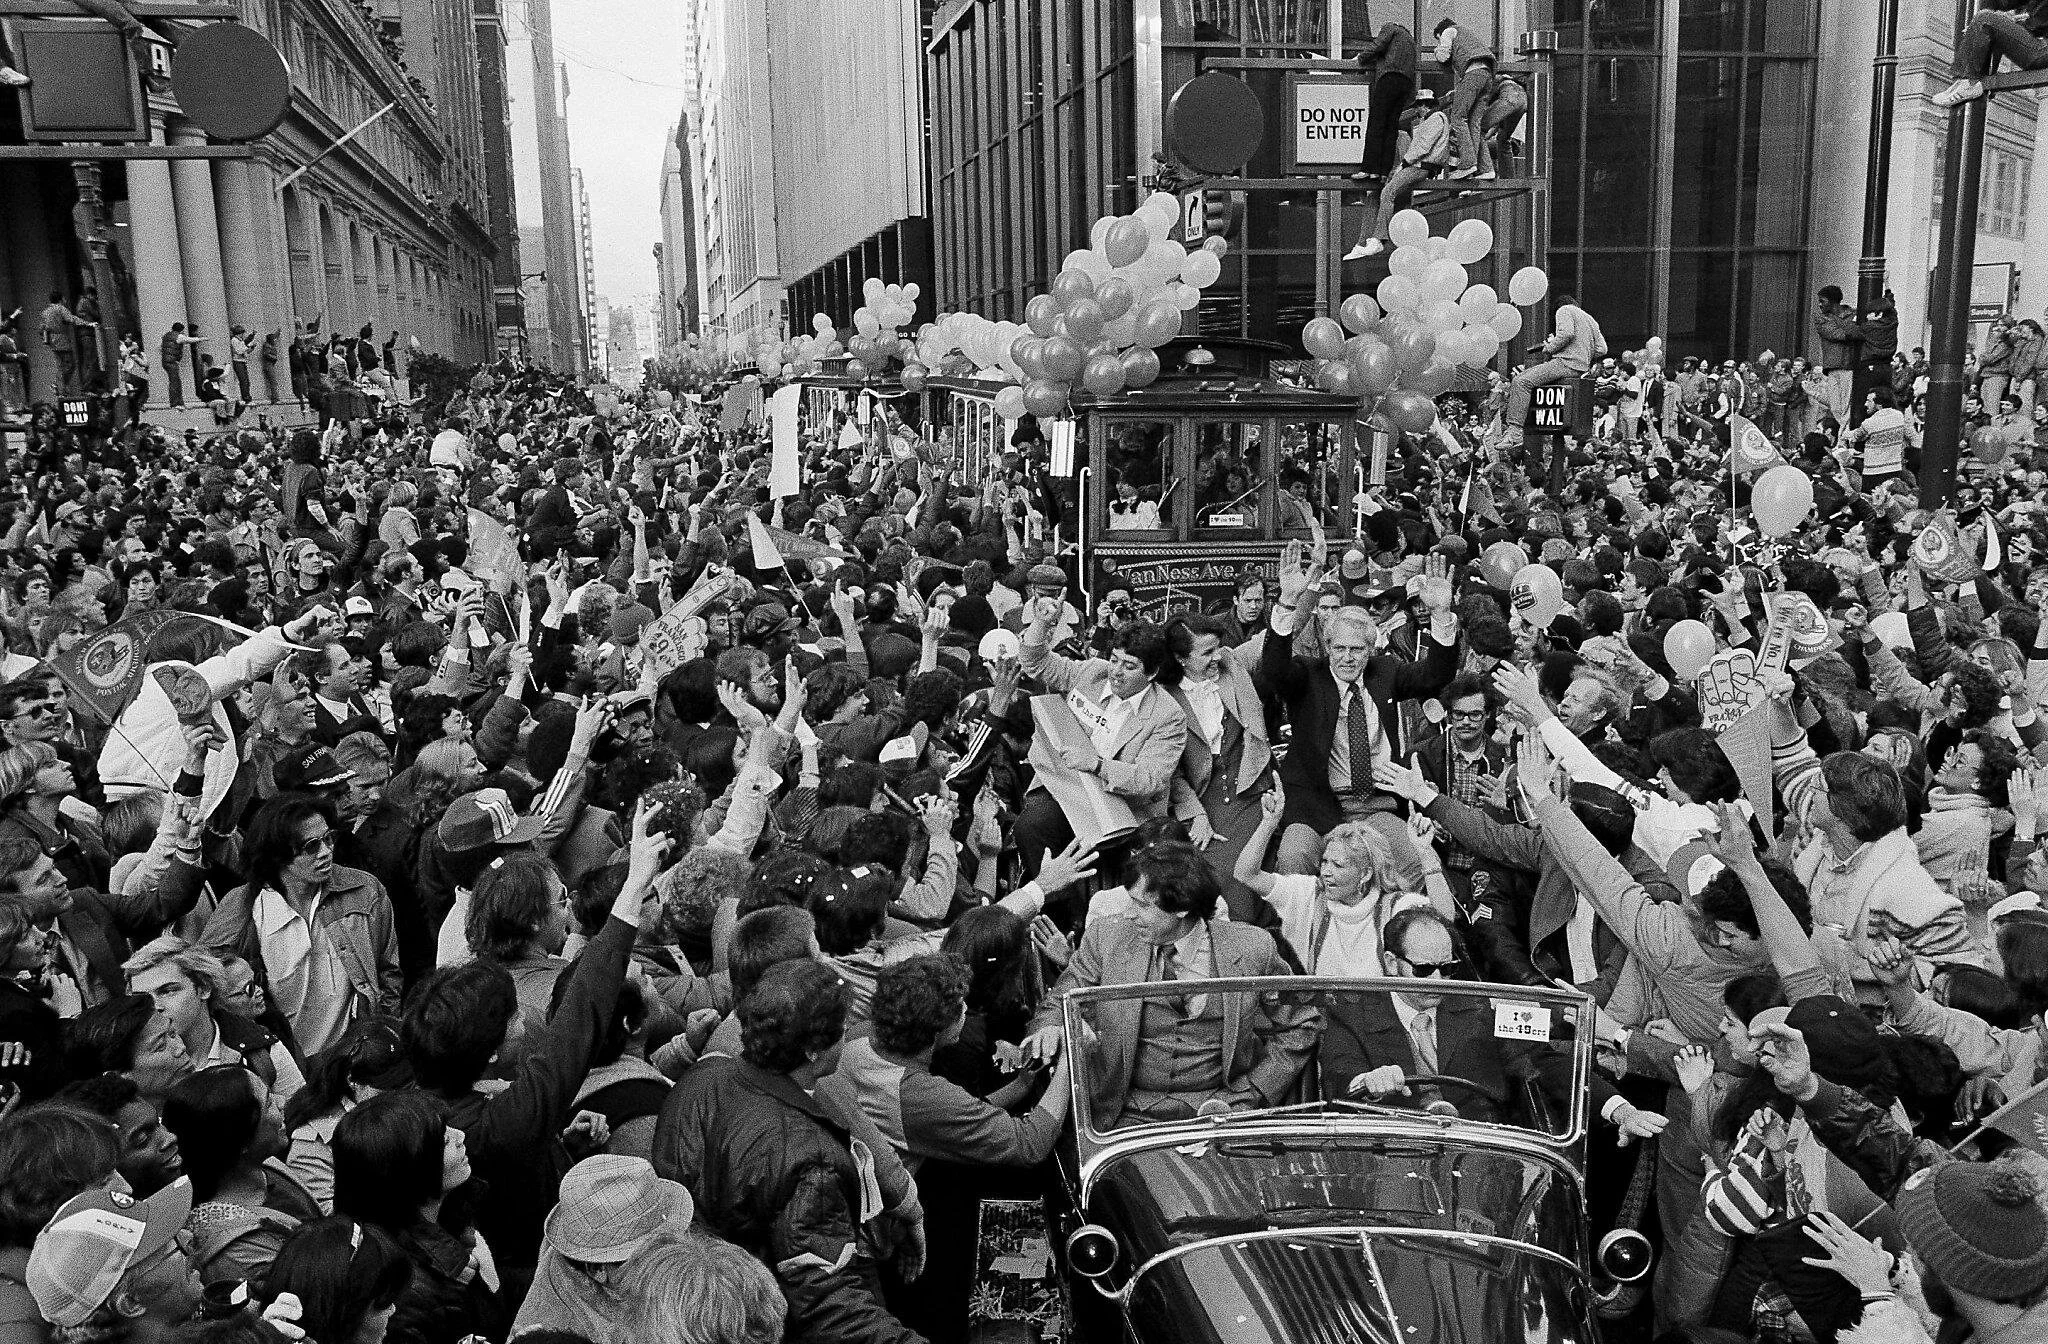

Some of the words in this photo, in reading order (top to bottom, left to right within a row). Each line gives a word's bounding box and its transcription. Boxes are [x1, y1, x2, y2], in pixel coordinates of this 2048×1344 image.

[1300, 107, 1325, 123] DO
[1330, 107, 1366, 123] NOT
[1306, 124, 1361, 140] ENTER
[1155, 564, 1201, 583] Ness
[96, 680, 128, 697] PONTIAC
[301, 754, 317, 769] SAN
[1513, 1012, 1519, 1022] I
[1498, 1024, 1514, 1033] the
